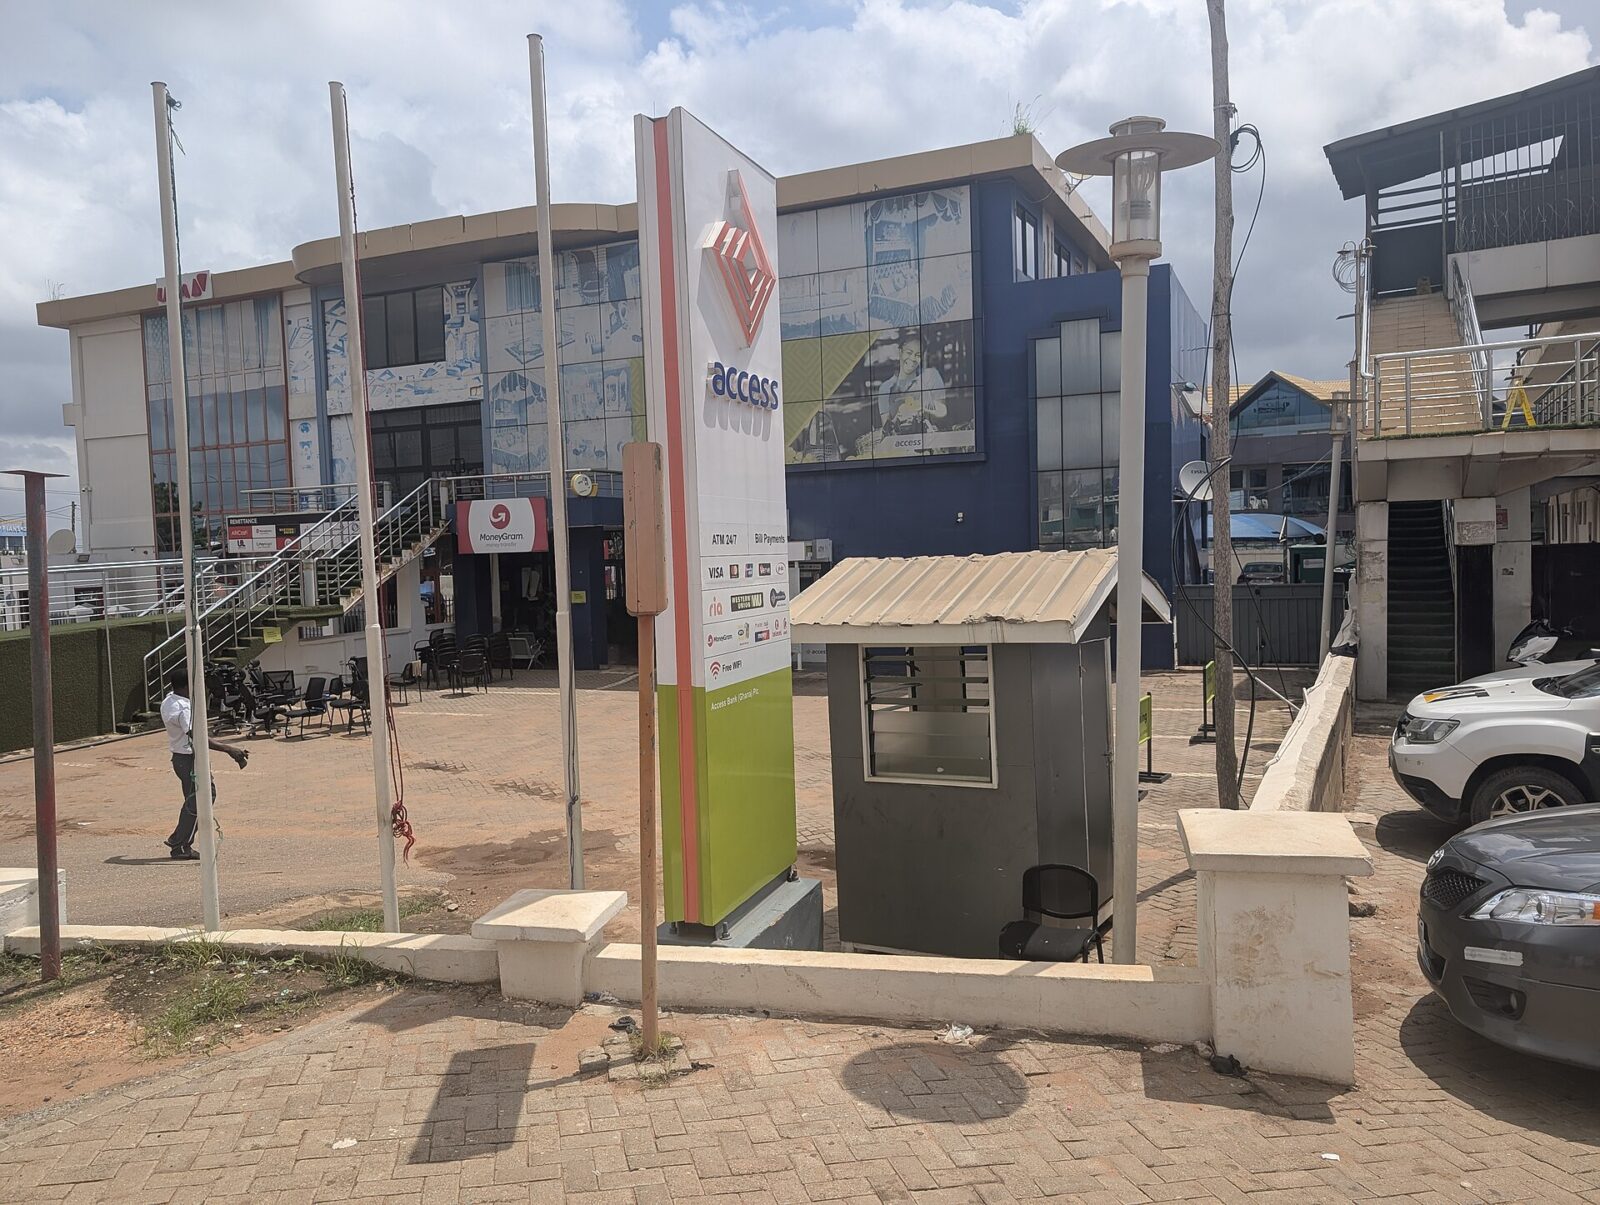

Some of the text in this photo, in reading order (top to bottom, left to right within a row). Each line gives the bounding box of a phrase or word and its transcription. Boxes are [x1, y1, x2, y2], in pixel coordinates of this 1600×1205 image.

[711, 361, 779, 410] access
[894, 439, 922, 448] access
[479, 532, 523, 542] MoneyGram
[712, 534, 737, 545] ATM 24/7
[754, 533, 785, 546] Bill Payments
[708, 566, 724, 579] VISA
[732, 595, 751, 603] WESTERN
[709, 596, 723, 617] ria
[722, 663, 732, 673] Free
[710, 700, 727, 711] Access
[727, 695, 738, 705] Bank
